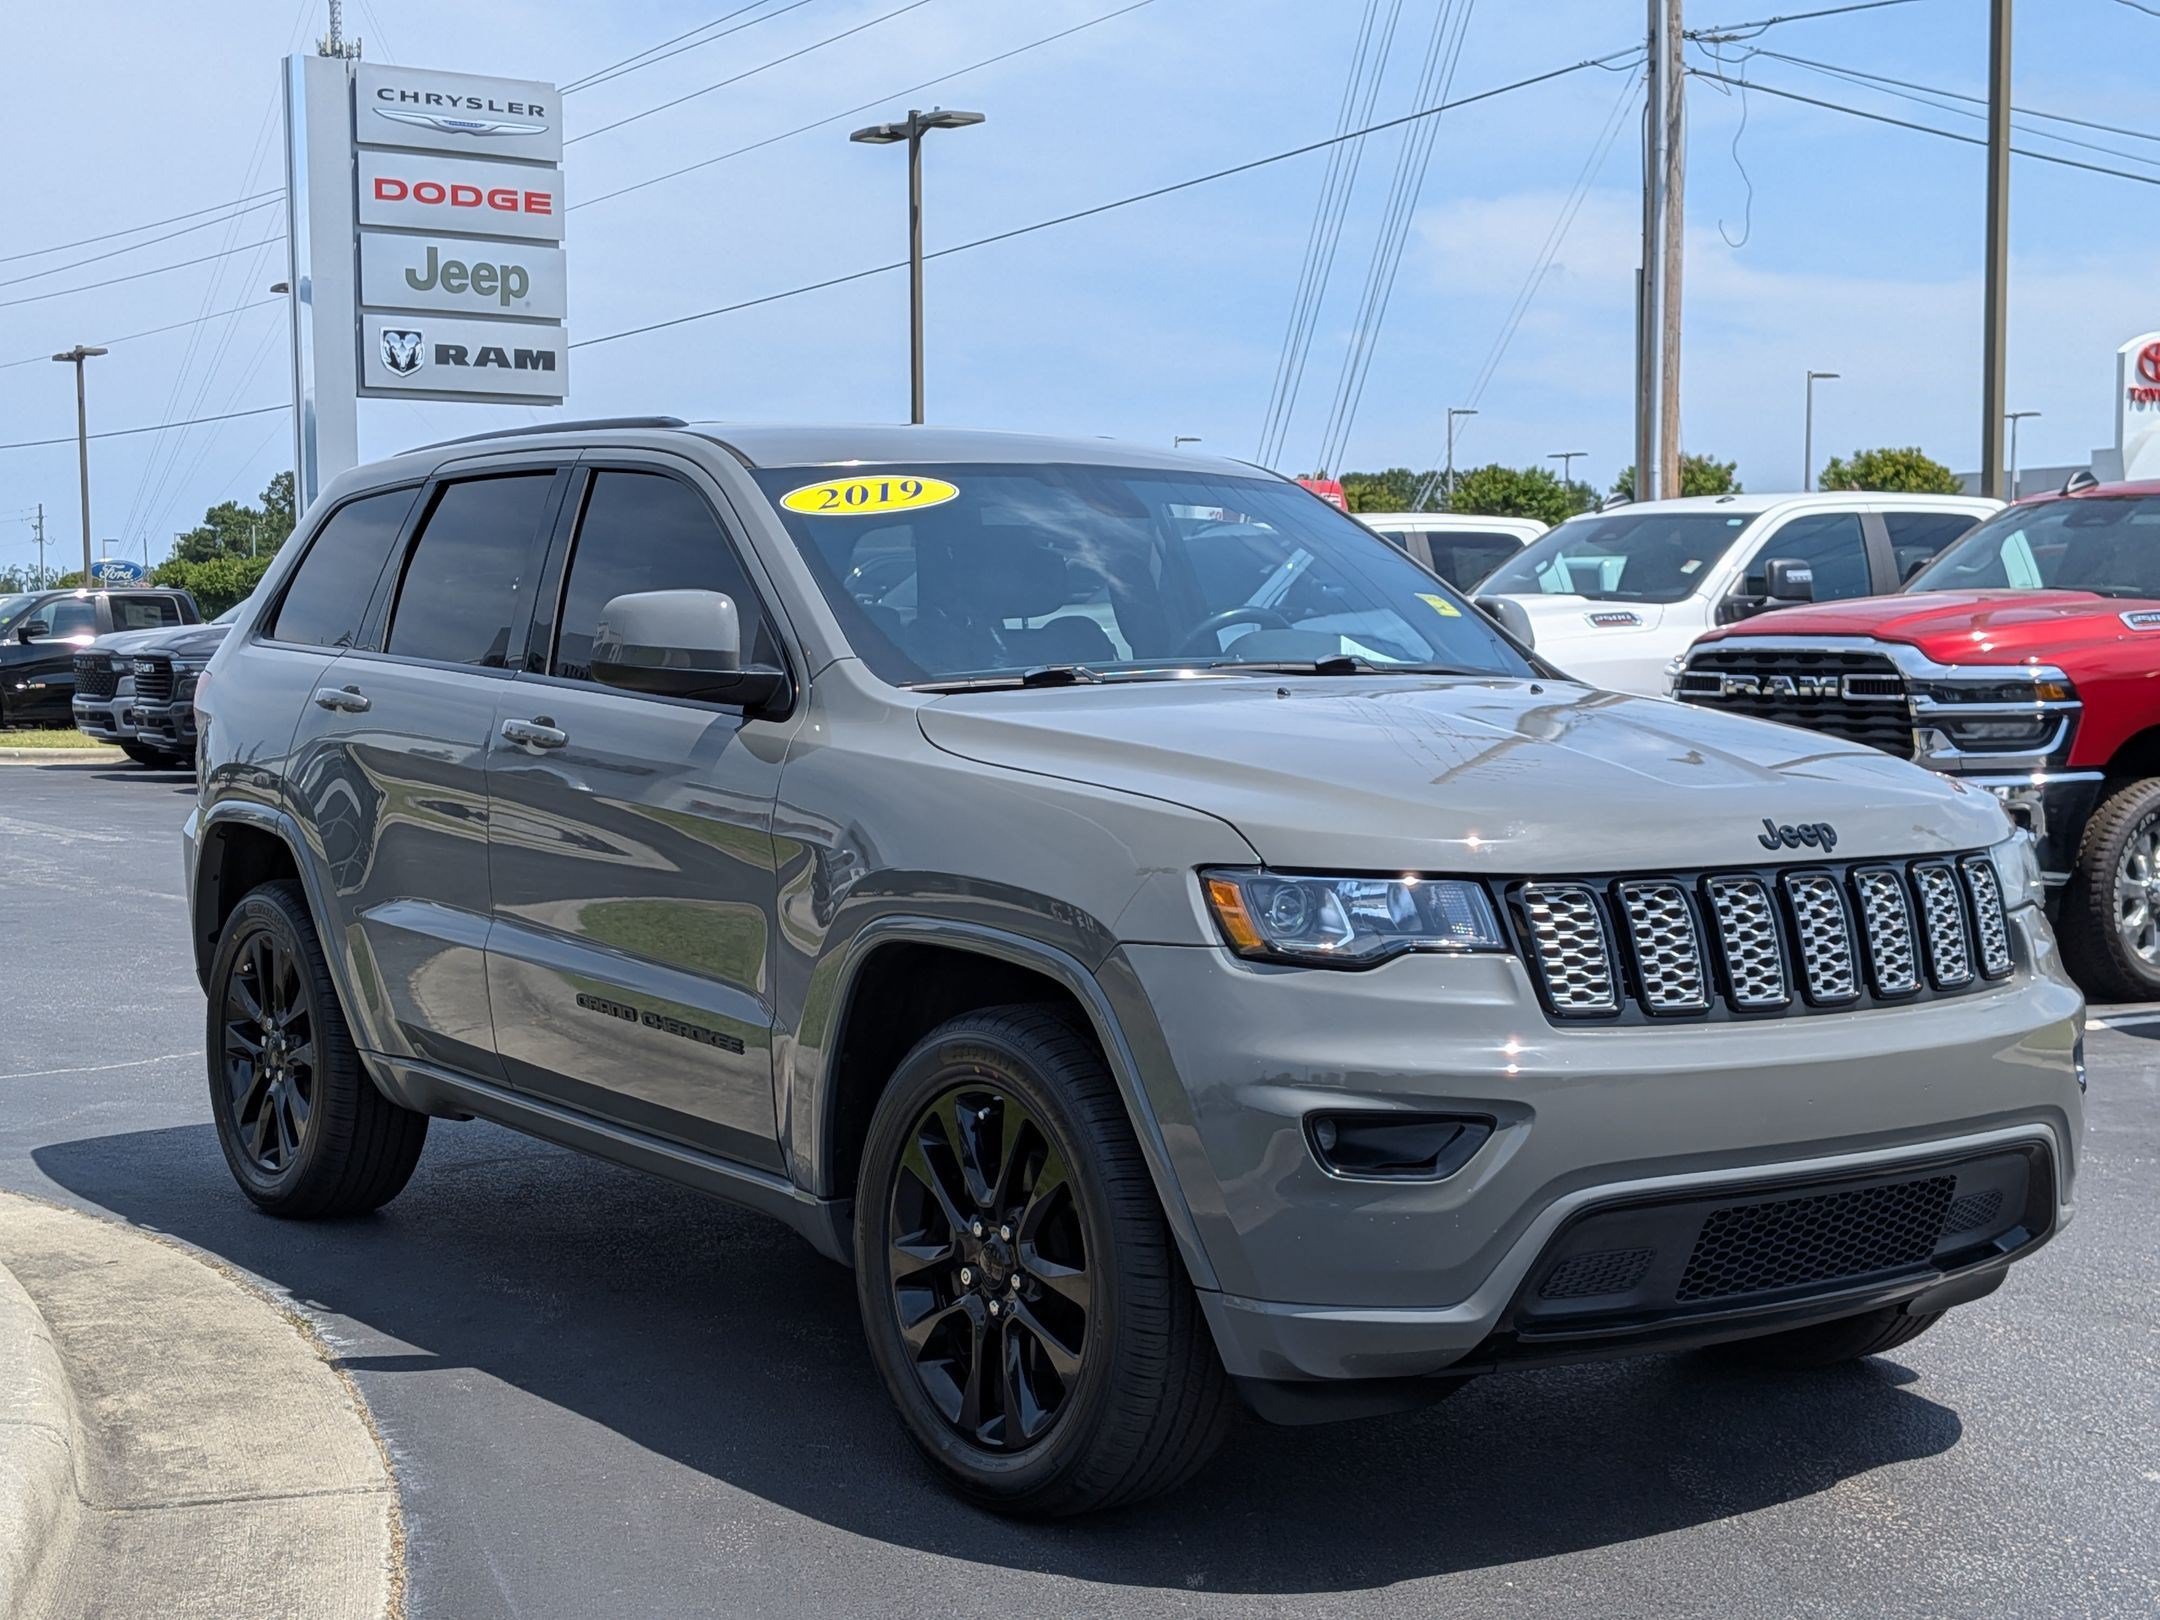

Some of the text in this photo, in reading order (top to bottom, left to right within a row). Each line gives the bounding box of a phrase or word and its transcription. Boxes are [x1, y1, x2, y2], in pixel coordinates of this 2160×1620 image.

[376, 87, 545, 118] CHRYSLER
[374, 177, 552, 215] DODGE
[404, 246, 530, 307] Jeep
[434, 343, 556, 372] RAM
[817, 480, 923, 510] 2019
[98, 564, 134, 580] Ford
[1727, 674, 1838, 697] RAM
[1757, 818, 1838, 854] Jeep
[576, 993, 746, 1055] GRAND CHEROKEE
